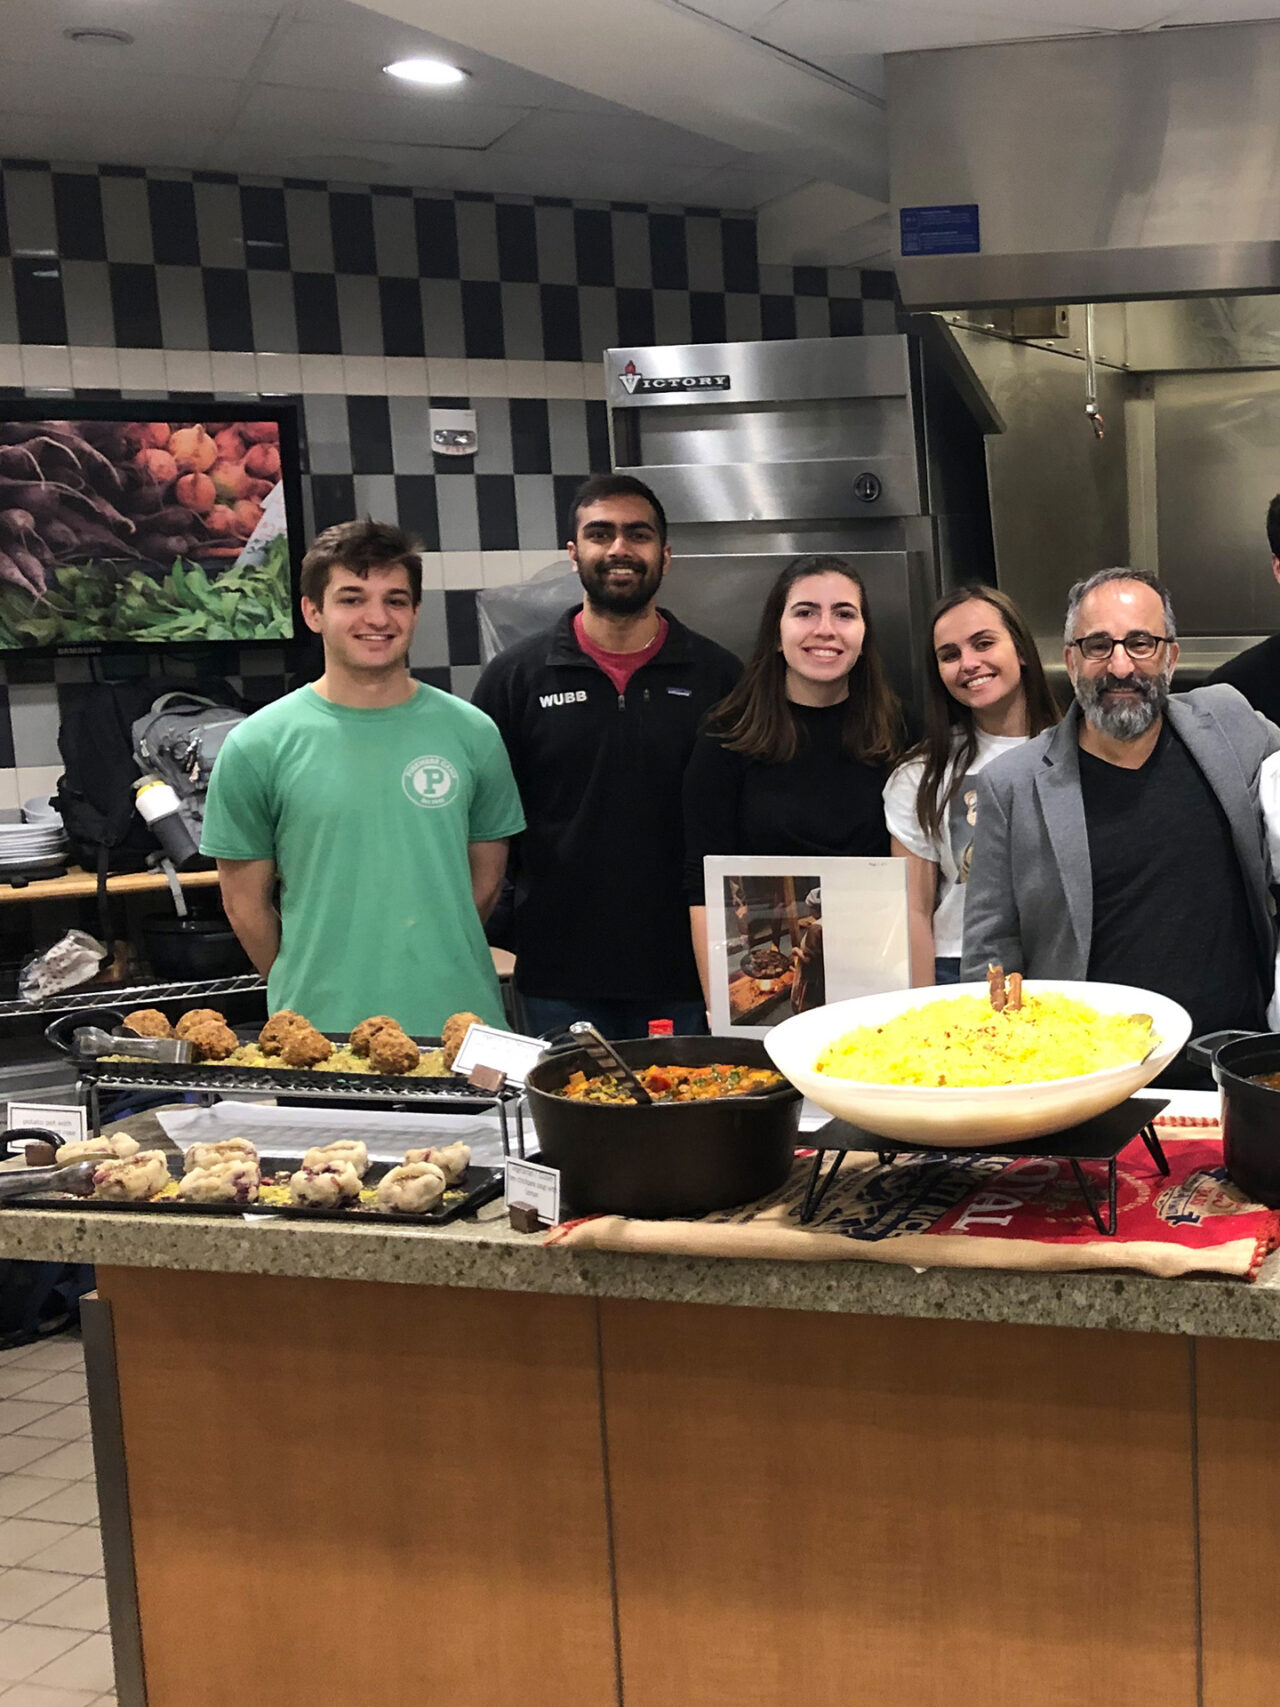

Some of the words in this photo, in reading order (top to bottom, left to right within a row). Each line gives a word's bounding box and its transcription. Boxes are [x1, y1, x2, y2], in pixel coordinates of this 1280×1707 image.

[618, 374, 726, 395] VICTORY
[57, 647, 103, 655] SAMSUNG
[539, 690, 588, 708] WUBB
[423, 768, 444, 794] P
[952, 1158, 1059, 1232] OYAL
